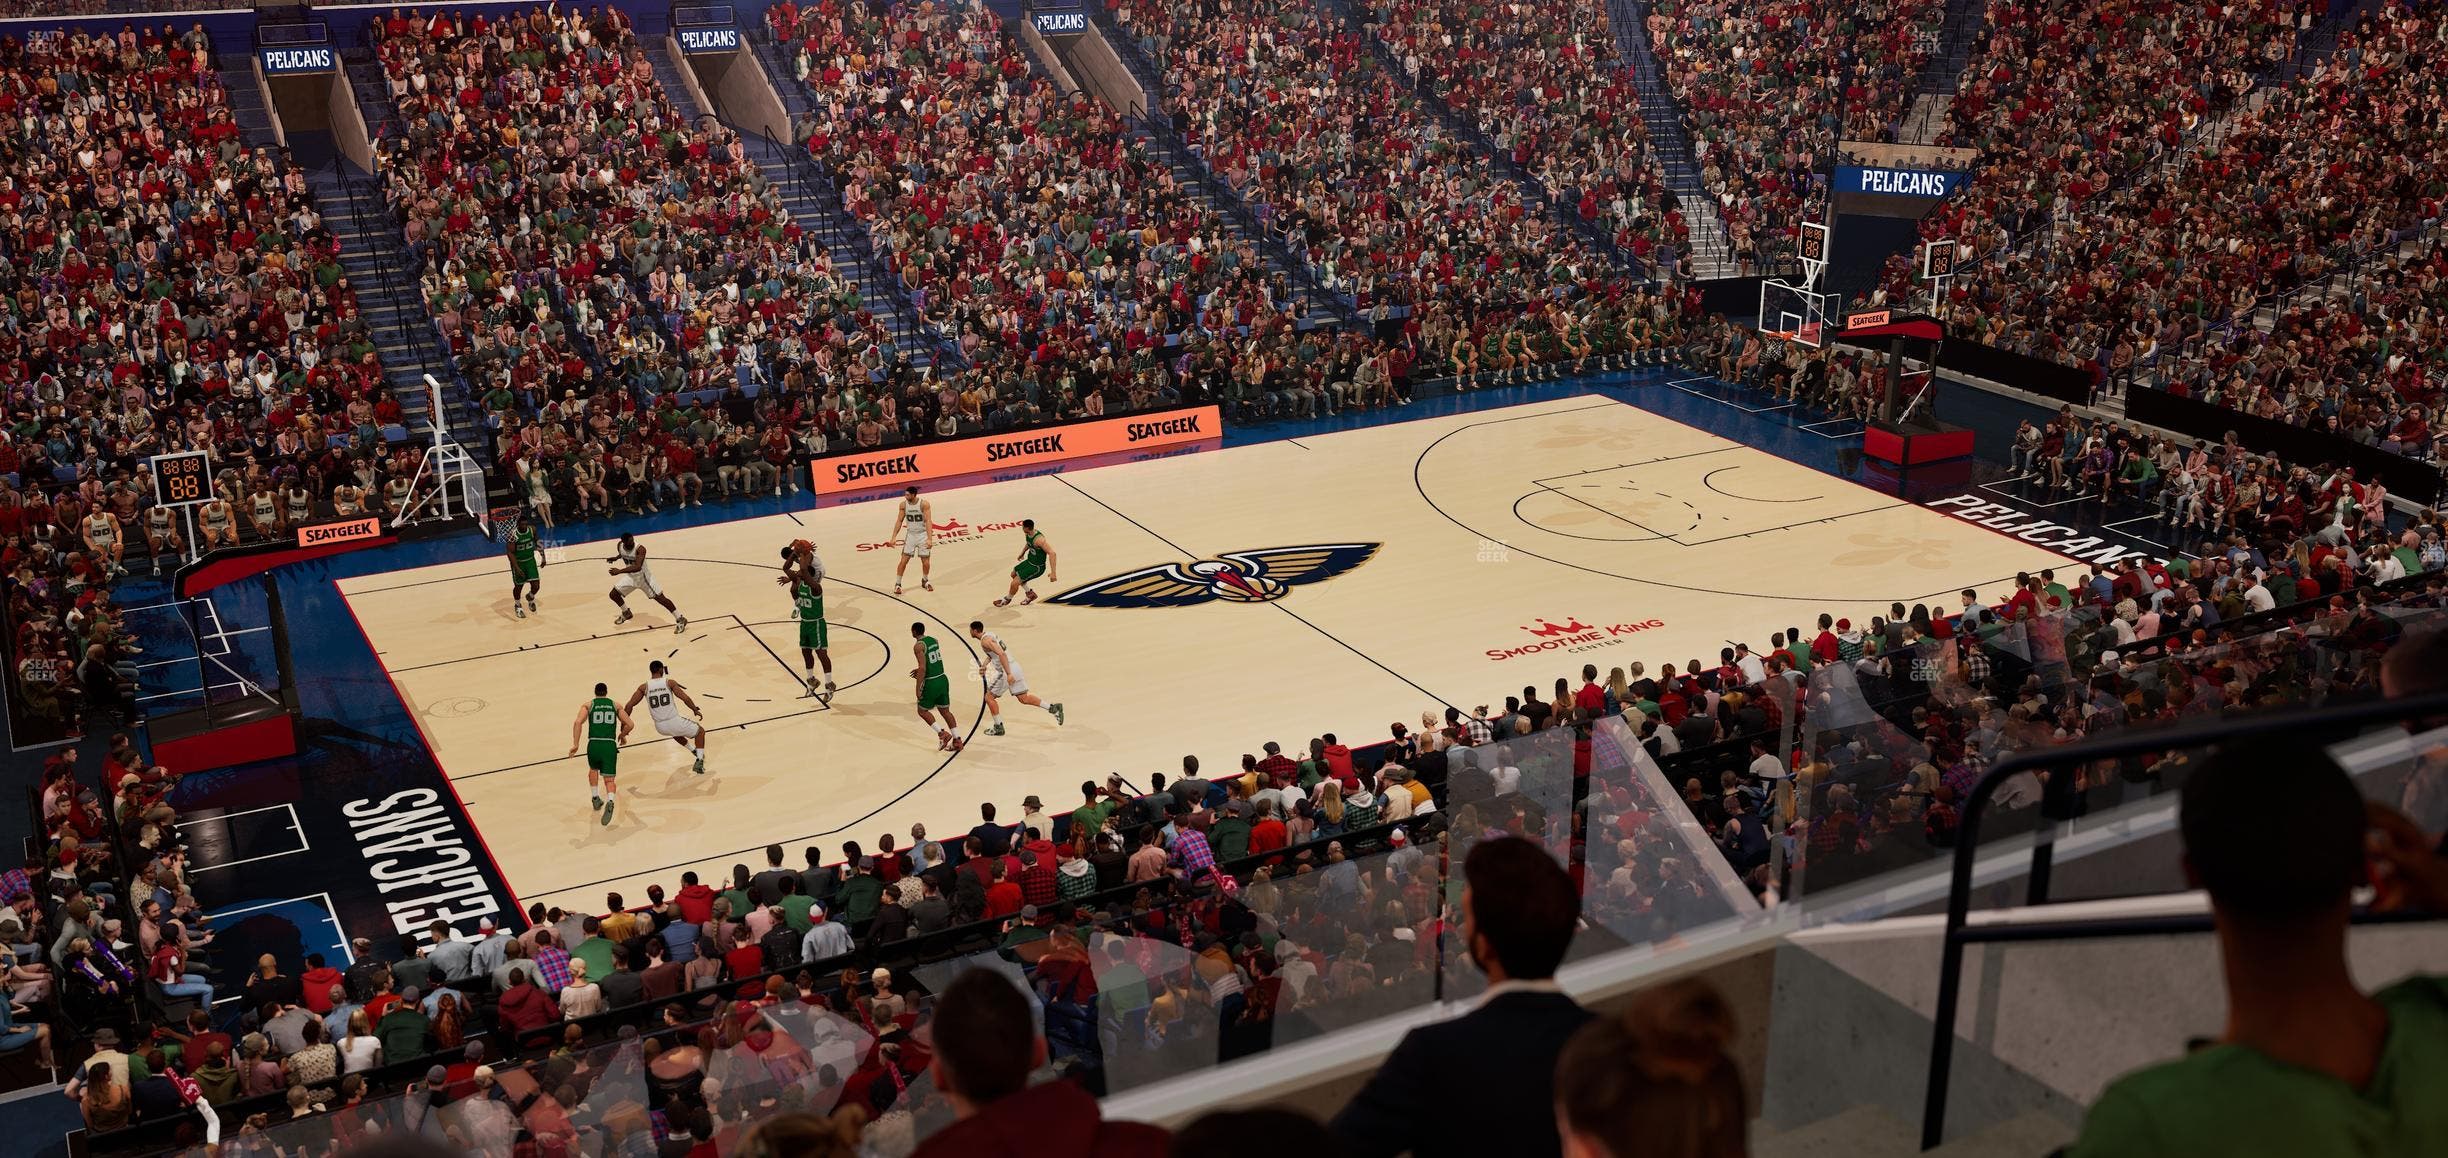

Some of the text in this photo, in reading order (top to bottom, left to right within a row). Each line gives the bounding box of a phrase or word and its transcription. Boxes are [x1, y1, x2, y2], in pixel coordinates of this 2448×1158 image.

[1037, 14, 1084, 31] PELICANS
[682, 30, 736, 49] PELICANS
[266, 49, 330, 69] PELICANS
[1861, 169, 1945, 196] PELICANS
[1852, 314, 1885, 327] SEATGEEK
[1127, 415, 1200, 442] SEATGEEK
[986, 433, 1064, 462] SEATGEEK
[836, 453, 920, 484] SEATGEEK
[169, 475, 199, 500] 88
[305, 521, 373, 543] SEATGEEK
[856, 529, 970, 552] SMOHIE
[1485, 631, 1605, 661] SMOOTHIE
[1567, 638, 1624, 654] CENTER
[649, 693, 670, 709] 00
[593, 711, 615, 724] 00
